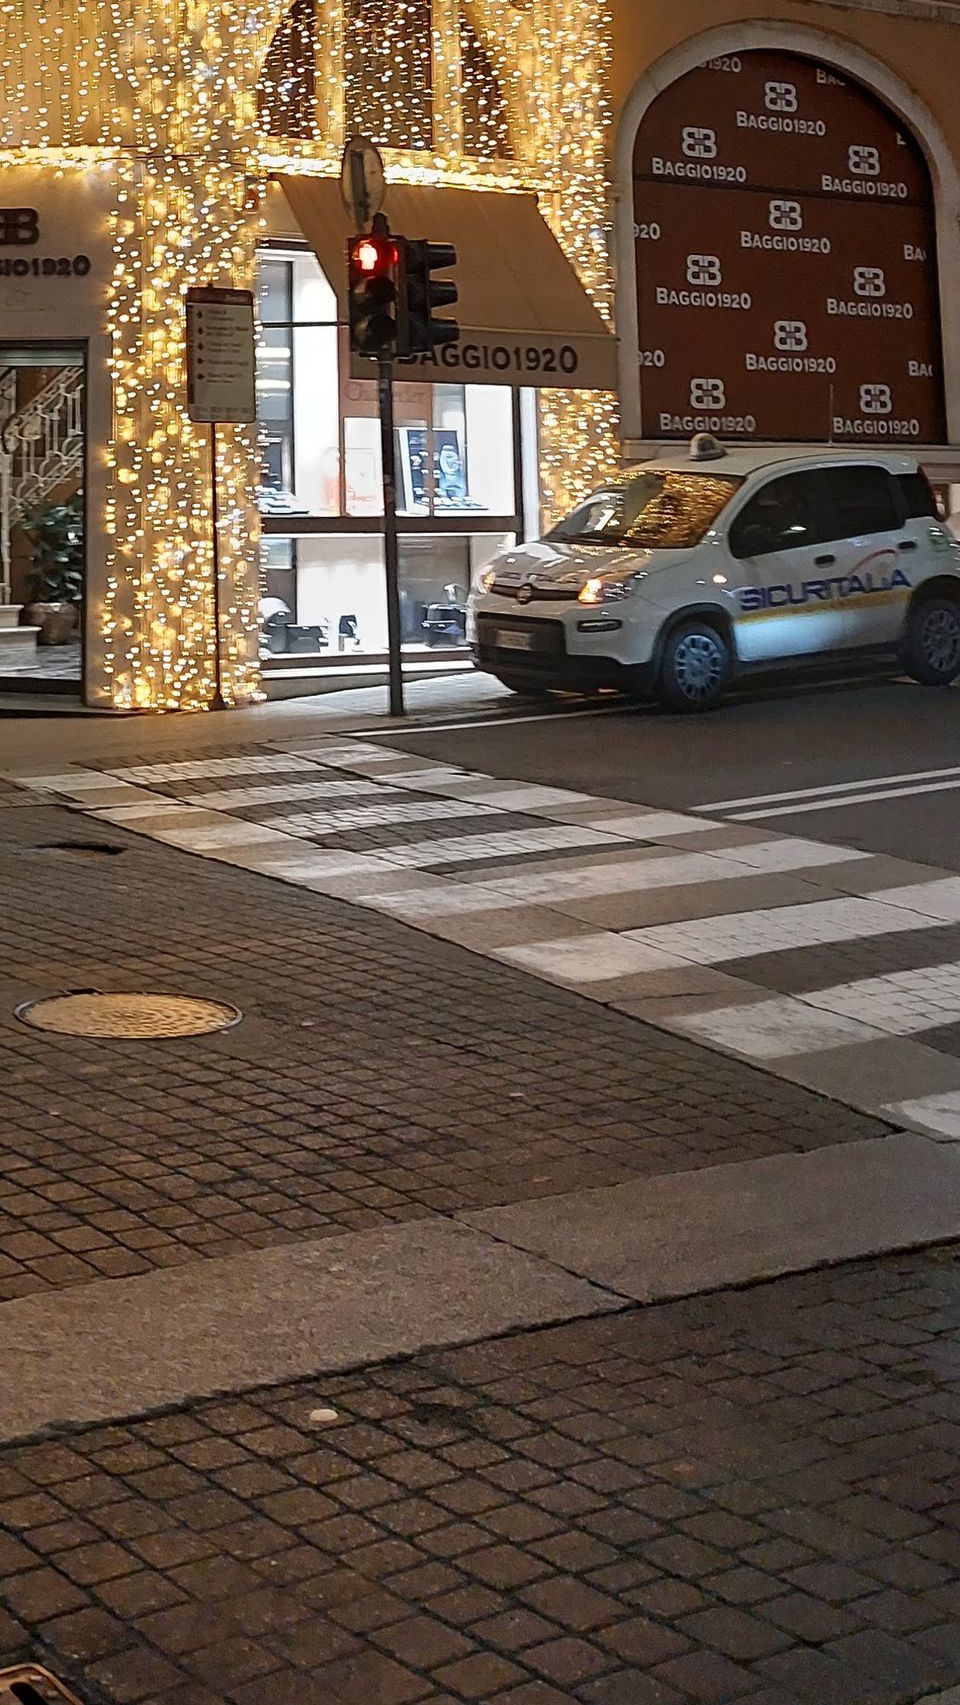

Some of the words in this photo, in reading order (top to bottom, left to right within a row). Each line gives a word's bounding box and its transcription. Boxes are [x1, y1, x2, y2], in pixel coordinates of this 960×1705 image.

[736, 110, 826, 137] BAGGIO1920
[651, 157, 746, 183] BAGGIO1920
[821, 175, 908, 198] BAGGIO1920
[740, 230, 831, 254] BAGGIO1920
[656, 287, 752, 310] BAGGIO1920
[826, 298, 913, 319] BAGGIO1920
[745, 354, 836, 374] BAGGIO1920
[659, 413, 756, 433] BAGGIO1920
[833, 417, 919, 436] BAGGIO1920
[741, 568, 912, 611] SICURITALIA
